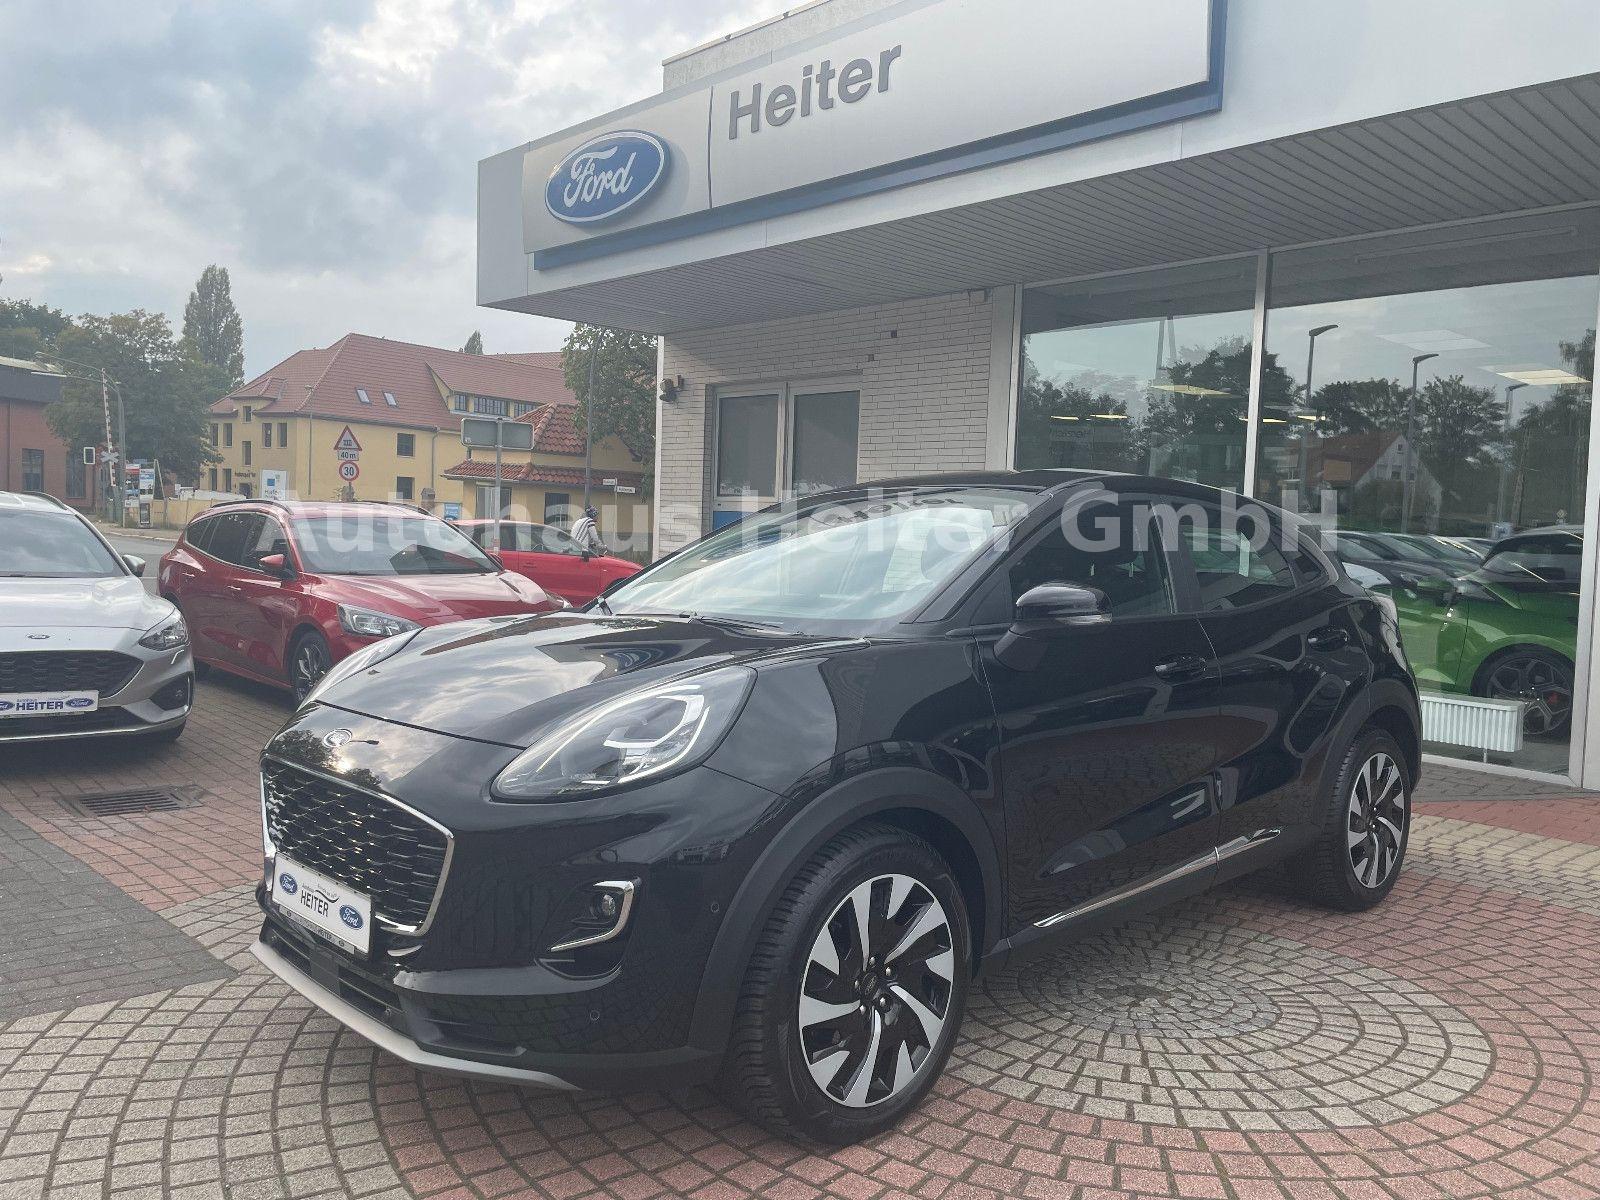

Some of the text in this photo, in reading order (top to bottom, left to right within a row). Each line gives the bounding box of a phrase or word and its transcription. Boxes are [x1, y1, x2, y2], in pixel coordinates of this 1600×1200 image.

[728, 45, 902, 140] Heiter
[563, 145, 637, 208] Ford
[340, 451, 349, 459] 40
[344, 466, 355, 476] 30
[16, 701, 64, 711] HEITER
[300, 889, 329, 918] HEITER
